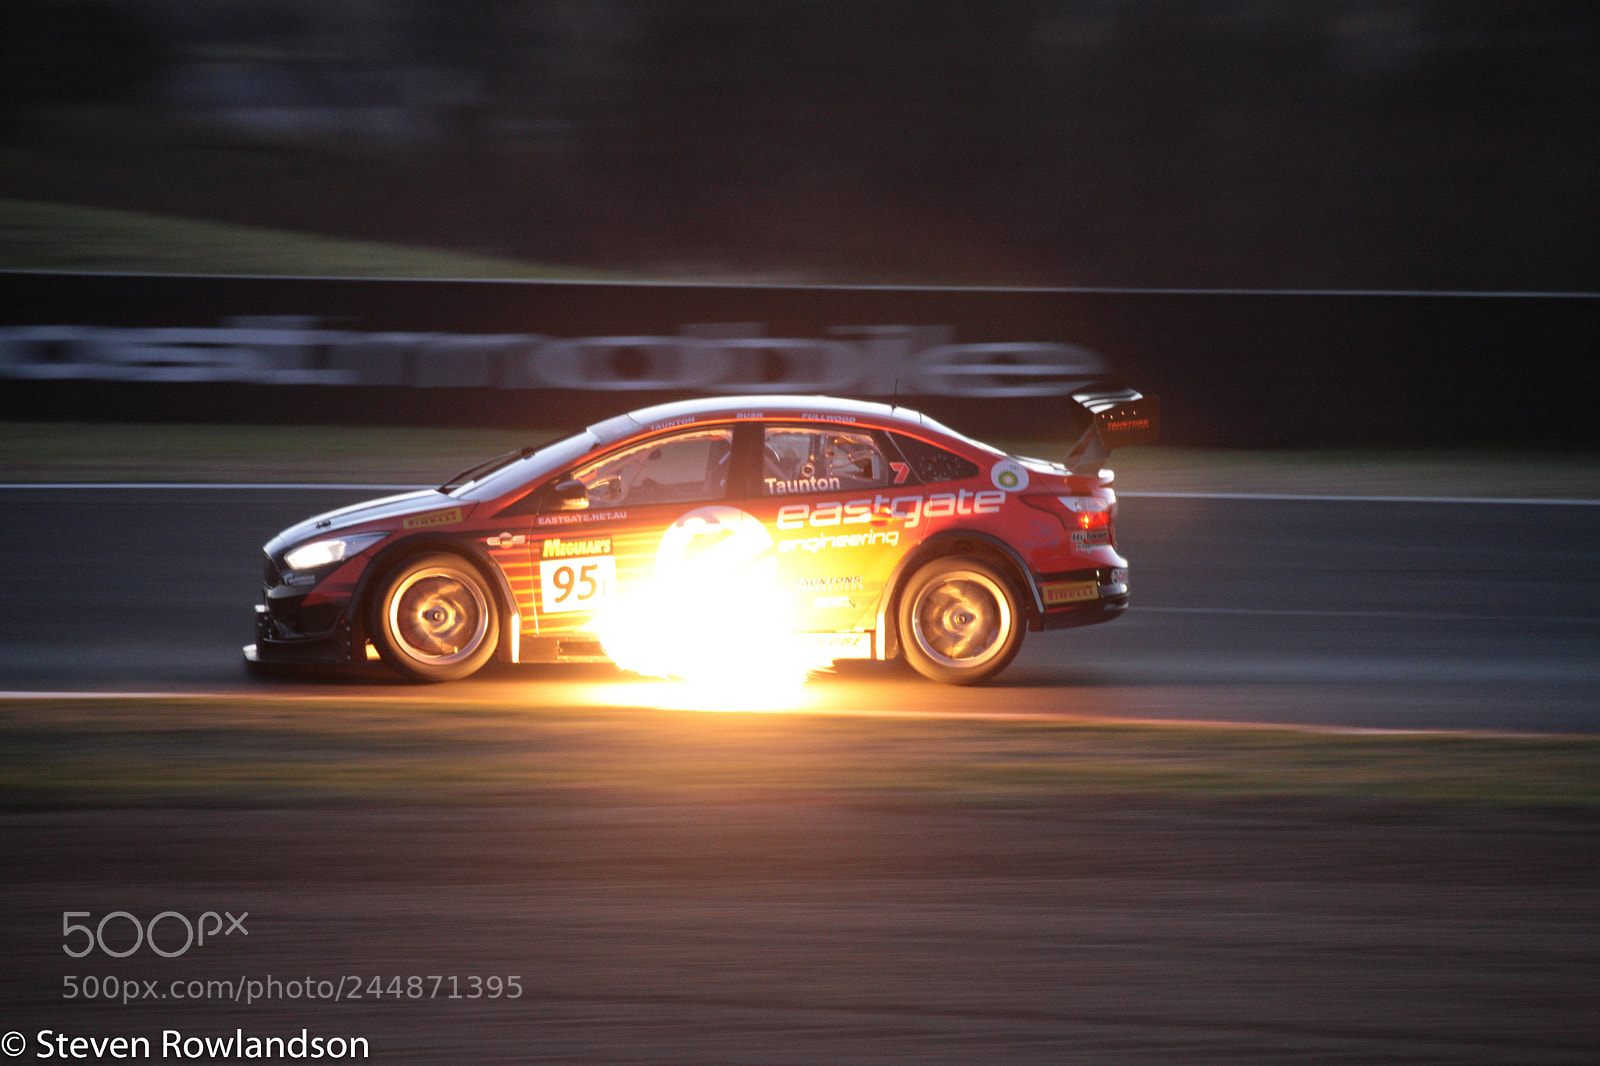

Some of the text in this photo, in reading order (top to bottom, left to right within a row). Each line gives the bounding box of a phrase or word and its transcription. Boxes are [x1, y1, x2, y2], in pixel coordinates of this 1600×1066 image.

[650, 416, 696, 431] TAUNTON
[801, 412, 857, 423] FULLWOOD
[764, 476, 840, 495] Taunton
[776, 489, 1006, 529] eastgate
[538, 511, 628, 526] EASTGATE.NET.AU
[778, 529, 899, 553] engineering
[553, 564, 598, 603] 95
[1047, 585, 1093, 600] PIRELLI
